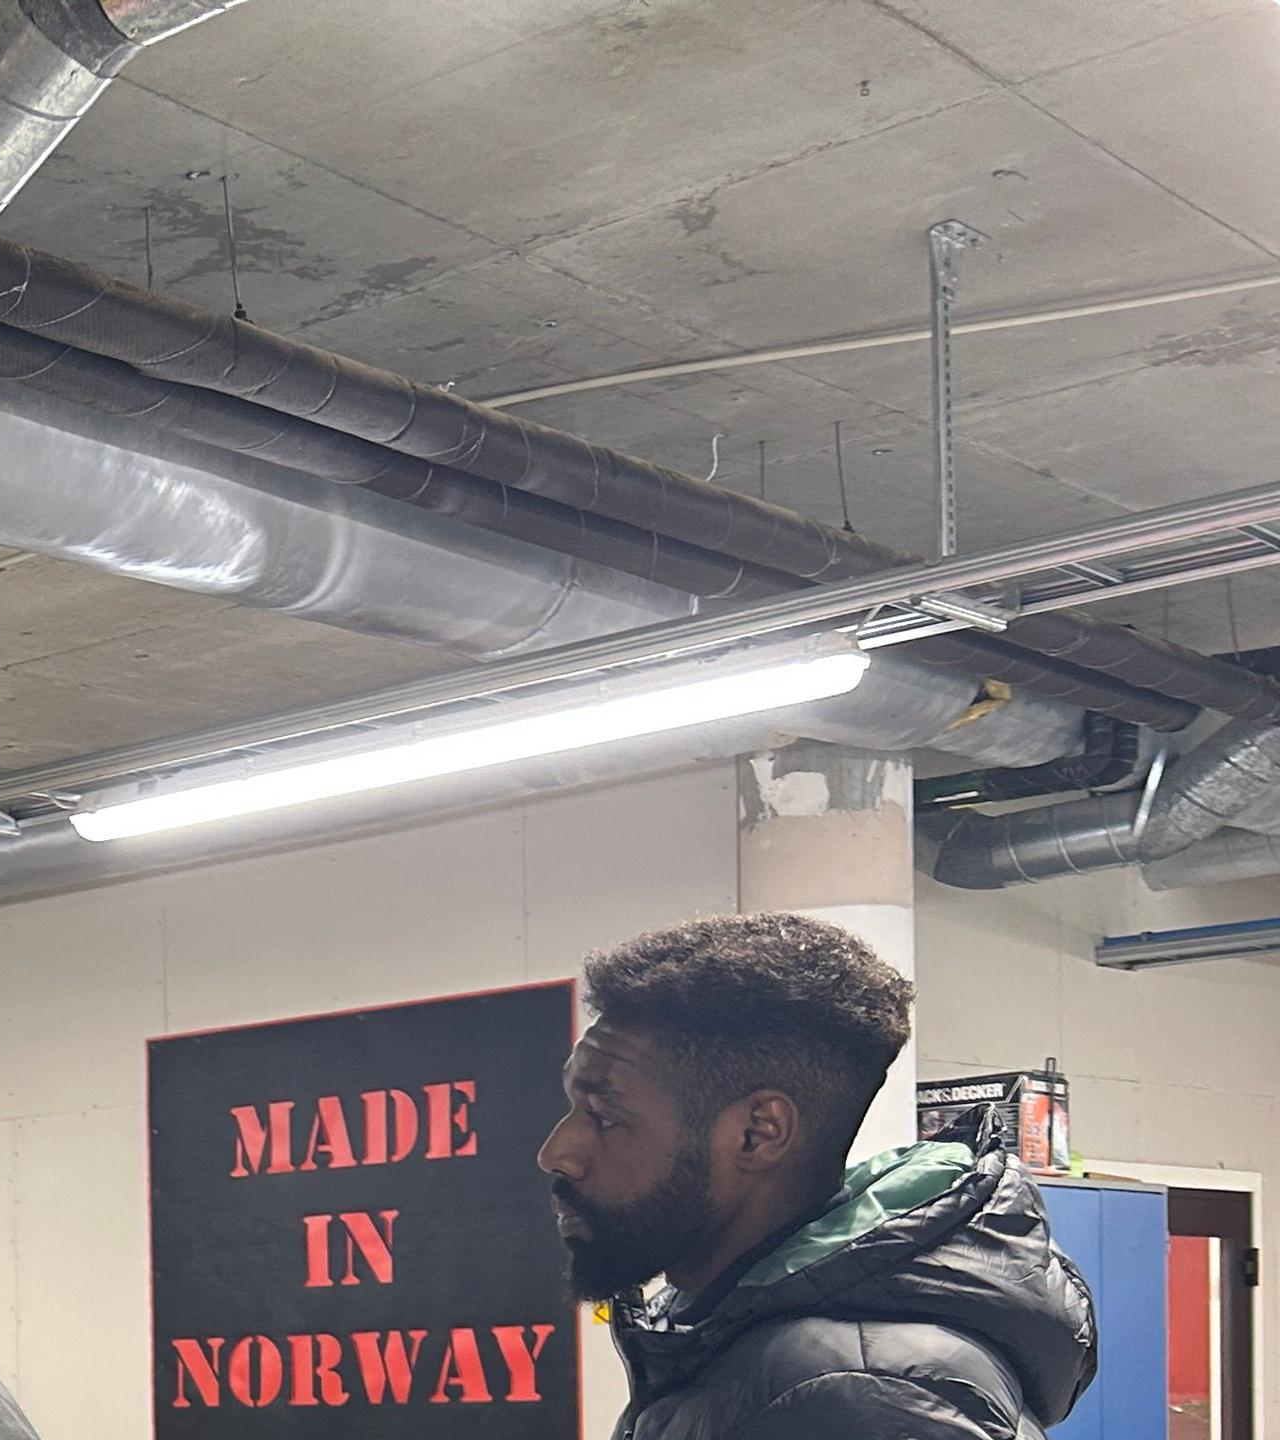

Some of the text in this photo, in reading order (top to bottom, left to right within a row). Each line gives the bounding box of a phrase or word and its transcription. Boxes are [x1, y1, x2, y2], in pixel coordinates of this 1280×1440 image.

[229, 1079, 478, 1178] MADE
[917, 1082, 1004, 1105] ACK&DECKER
[302, 1209, 400, 1288] IN
[171, 1323, 556, 1408] NORWAY
